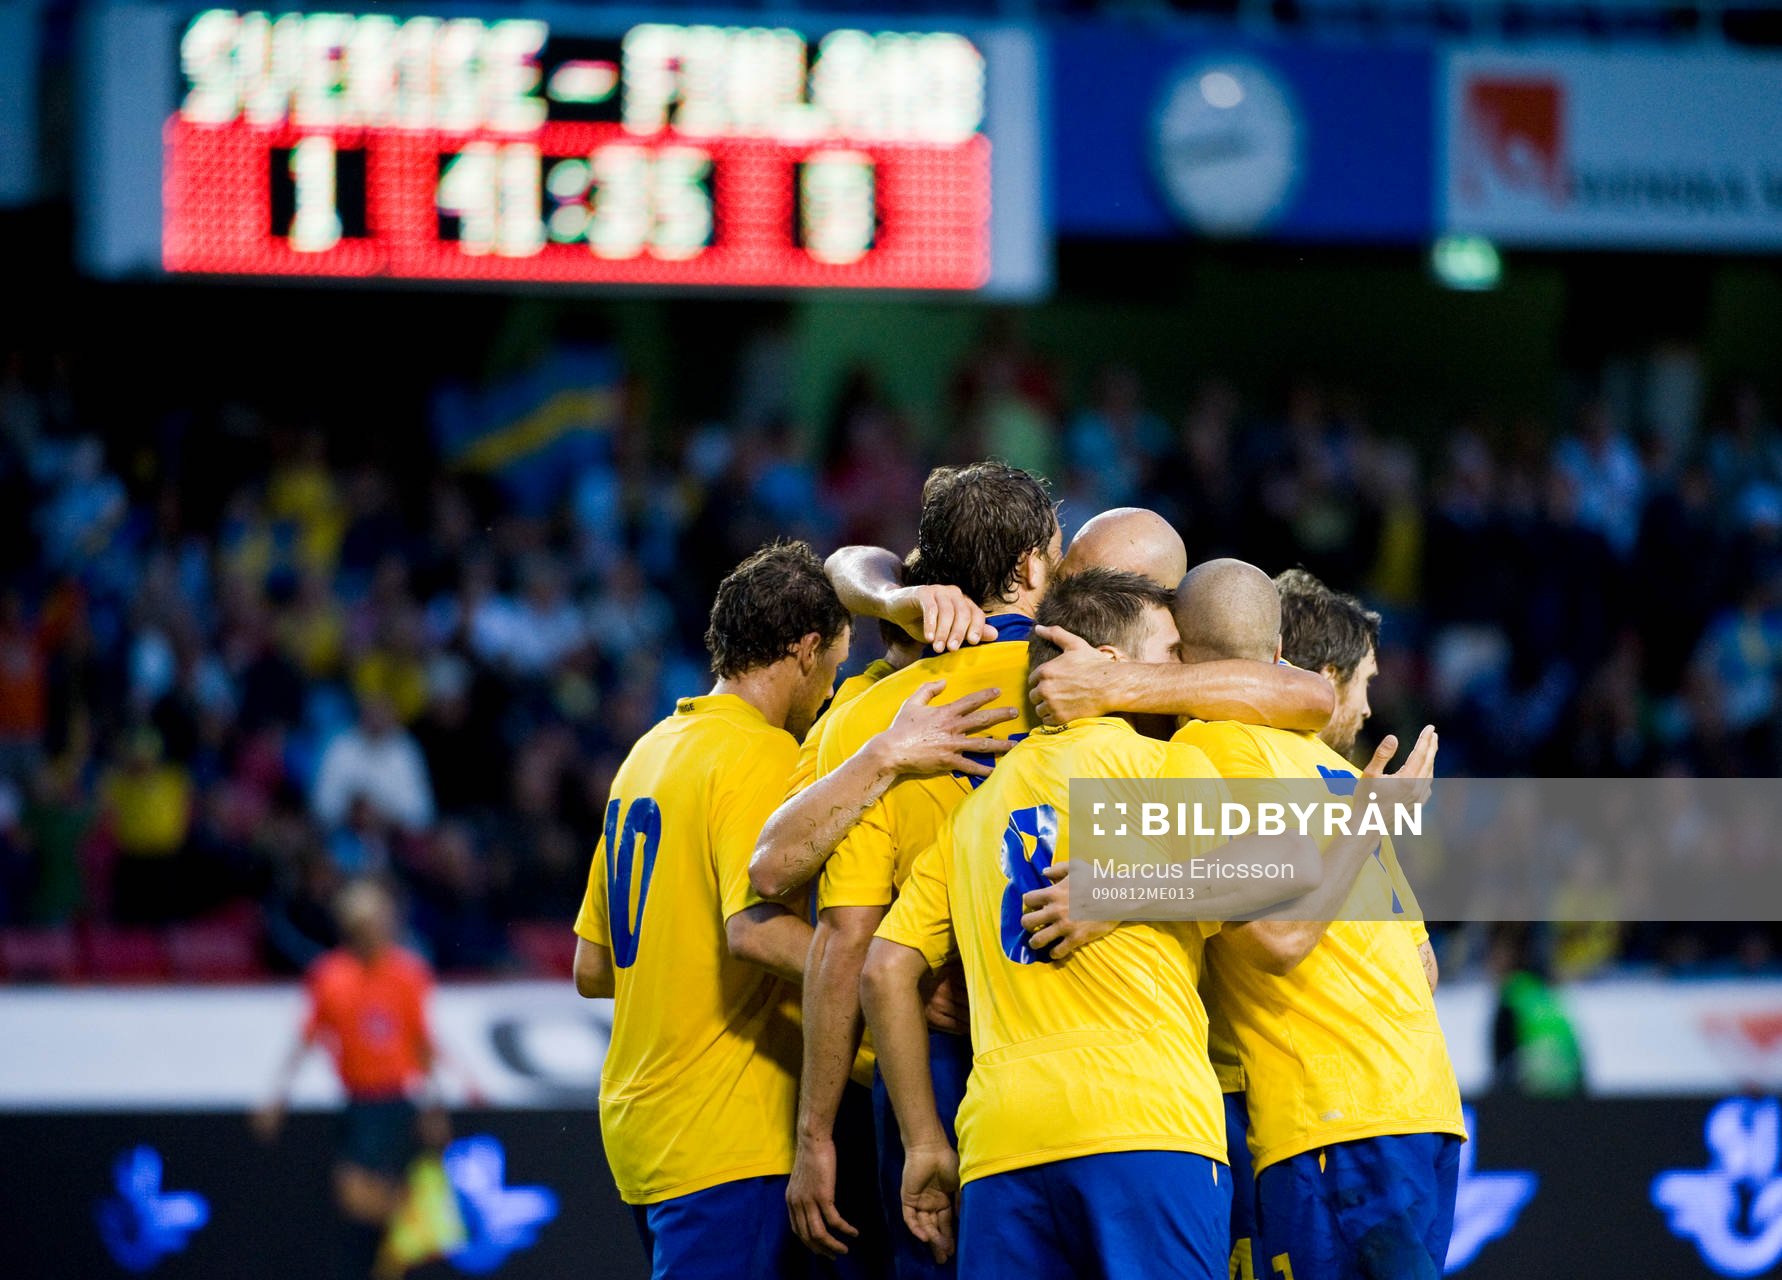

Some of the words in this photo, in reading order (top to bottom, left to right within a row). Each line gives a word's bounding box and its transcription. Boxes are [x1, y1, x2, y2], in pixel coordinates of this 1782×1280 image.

[180, 9, 550, 132] SVERIGE
[621, 23, 986, 143] FINLAND
[289, 135, 343, 253] 1
[799, 150, 875, 265] 0
[605, 797, 662, 969] 10
